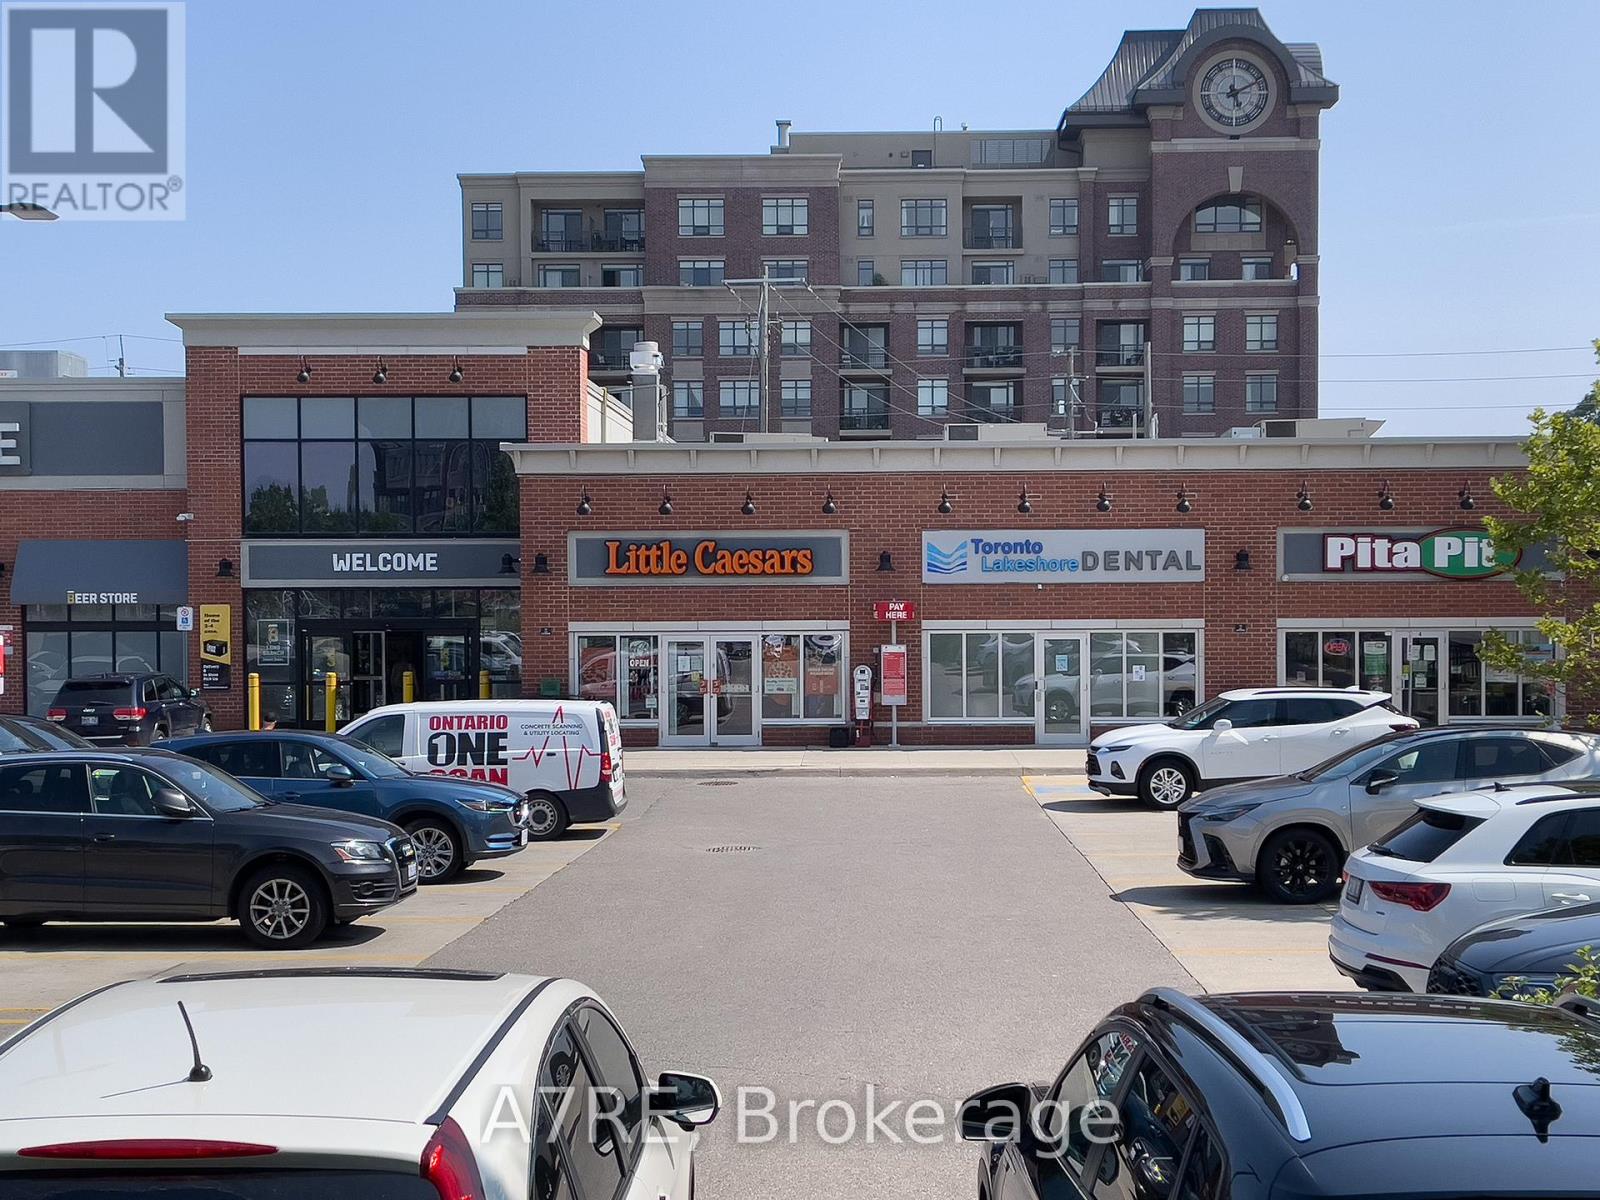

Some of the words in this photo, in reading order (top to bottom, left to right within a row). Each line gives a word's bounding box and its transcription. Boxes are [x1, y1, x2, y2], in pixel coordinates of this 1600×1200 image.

[971, 538, 1043, 555] Toronto
[1327, 537, 1421, 568] Pita
[1434, 537, 1496, 568] Pit
[332, 552, 438, 572] WELCOME
[605, 540, 688, 575] Little
[694, 540, 813, 576] Caesars
[981, 556, 1079, 572] Lakeshore
[1081, 550, 1202, 571] DENTAL
[67, 591, 98, 604] BEER
[99, 592, 138, 604] STORE
[885, 611, 908, 619] HERE
[889, 603, 905, 611] PAY
[629, 659, 650, 667] OPEN
[429, 715, 508, 730] ONTARIO
[427, 732, 508, 766] ONE
[429, 768, 508, 786] AN
